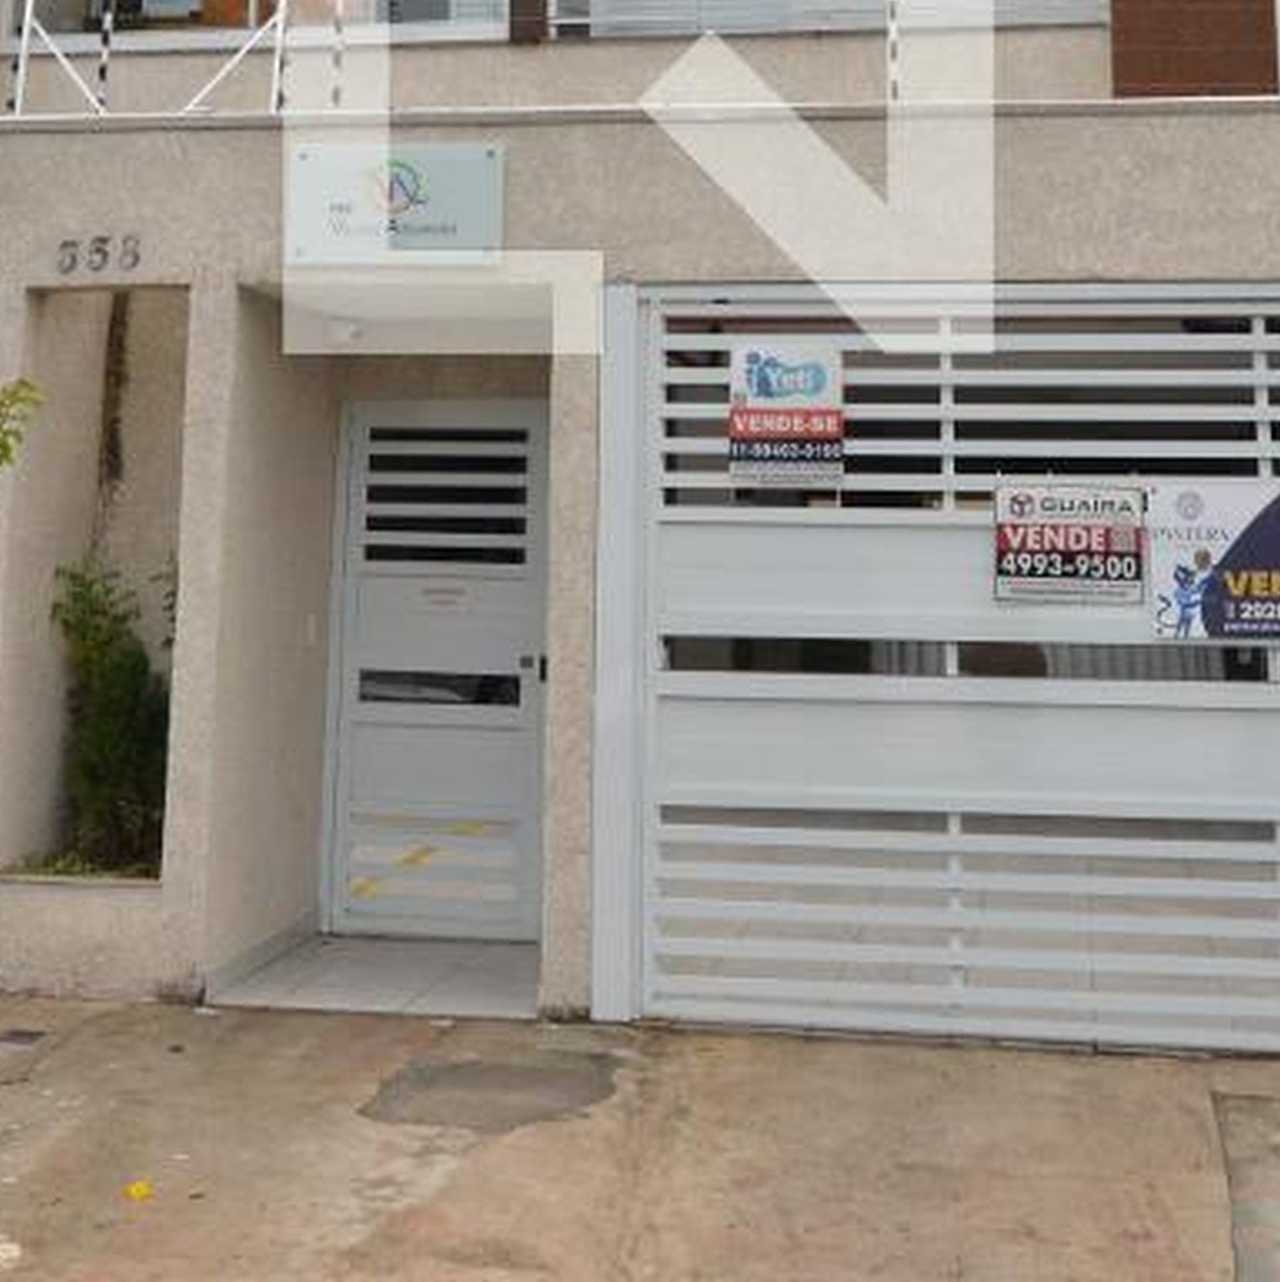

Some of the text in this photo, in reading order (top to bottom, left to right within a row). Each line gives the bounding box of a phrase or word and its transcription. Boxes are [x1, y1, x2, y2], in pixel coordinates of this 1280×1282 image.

[733, 413, 840, 433] VENDE-SE
[1004, 526, 1106, 552] VENDE
[1001, 553, 1136, 579] 4993-9500
